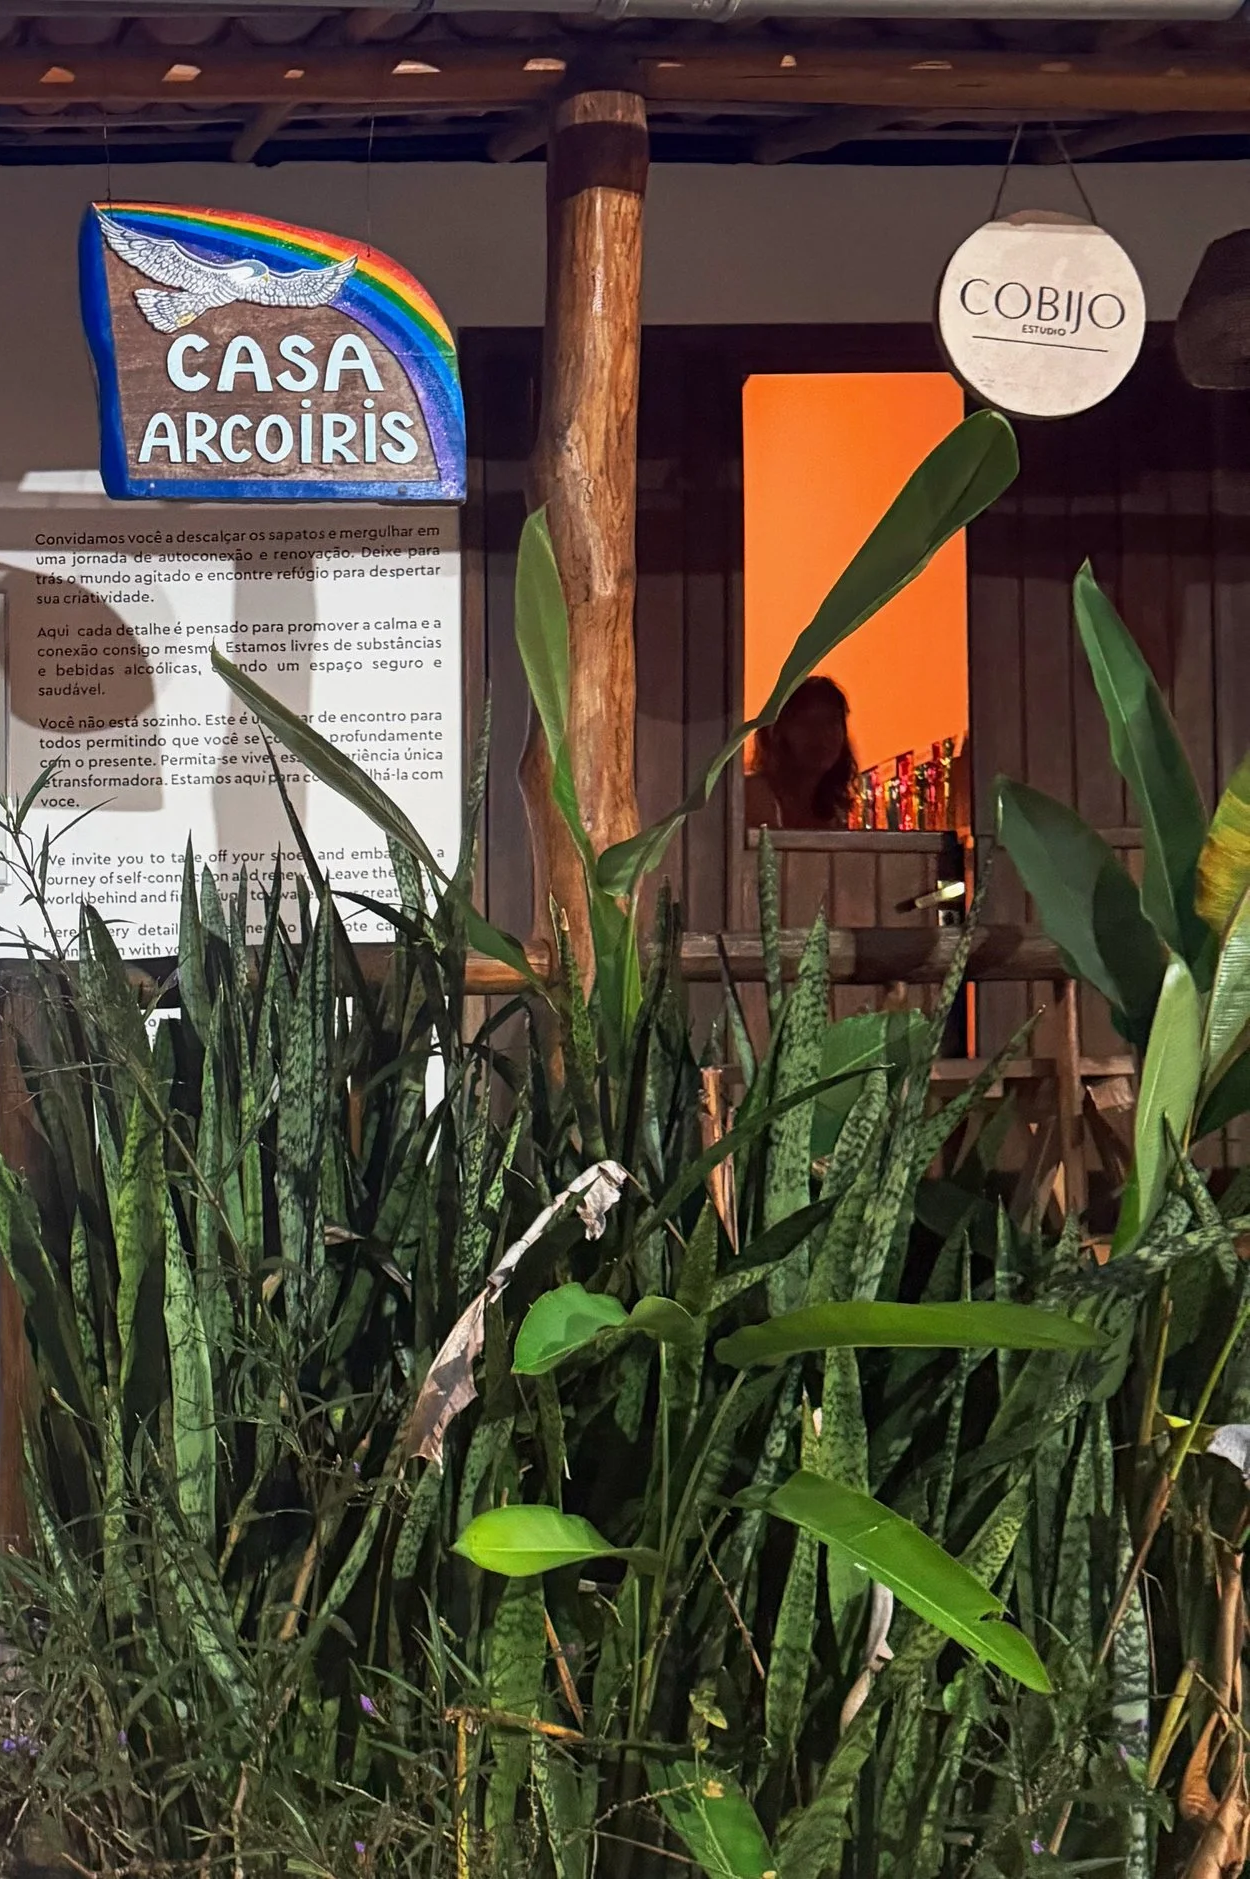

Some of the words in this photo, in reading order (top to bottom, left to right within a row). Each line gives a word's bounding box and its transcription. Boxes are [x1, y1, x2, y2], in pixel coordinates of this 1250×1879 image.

[960, 278, 1125, 334] COBIJO
[1022, 324, 1066, 336] ESTUDIO
[166, 333, 384, 392] CASA
[35, 533, 125, 546] Convidamos
[127, 531, 162, 544] você
[166, 534, 173, 543] a
[177, 530, 246, 545] descalçar
[250, 531, 265, 541] os
[269, 529, 325, 543] sapatos
[328, 530, 336, 539] e
[340, 525, 413, 541] mergulhar
[418, 527, 440, 536] em
[36, 555, 66, 565] uma
[72, 552, 127, 567] jornada
[133, 551, 152, 563] de
[159, 549, 253, 562] autoconexão
[259, 552, 268, 560] e
[274, 546, 354, 561] renovação.
[362, 545, 402, 558] Deixe
[408, 547, 440, 559] para
[36, 572, 63, 585] trás
[67, 576, 75, 584] o
[80, 571, 130, 584] mundo
[135, 570, 190, 585] agitado
[195, 573, 203, 581] e
[208, 569, 272, 581] encontre
[277, 567, 329, 581] refúgio
[333, 568, 365, 580] para
[369, 565, 441, 578] despertar
[37, 595, 59, 604] sua
[64, 591, 154, 604] criatividade.
[37, 624, 69, 639] Aqui
[78, 624, 112, 636] cada
[116, 622, 170, 636] detalhe
[174, 622, 182, 634] é
[187, 621, 248, 636] pensado
[252, 623, 284, 635] para
[288, 620, 359, 634] promover
[363, 621, 370, 630] a
[374, 618, 417, 630] calma
[421, 620, 430, 629] e
[433, 619, 441, 629] a
[37, 644, 98, 657] conexão
[103, 644, 160, 657] consigo
[226, 641, 286, 653] Estamos
[291, 639, 329, 651] livres
[334, 638, 352, 650] de
[357, 636, 442, 650] substâncias
[38, 668, 46, 676] e
[56, 664, 114, 676] bebidas
[124, 662, 202, 677] alcoólicas,
[277, 662, 299, 672] um
[310, 661, 362, 673] espaço
[372, 658, 424, 671] seguro
[434, 659, 442, 667] e
[38, 683, 105, 696] saudável.
[39, 716, 74, 728] Você
[79, 716, 104, 728] não
[108, 714, 138, 728] está
[142, 714, 201, 727] sozinho.
[205, 714, 236, 726] Este
[239, 712, 248, 725] é
[318, 711, 336, 722] de
[340, 711, 406, 722] encontro
[411, 712, 442, 723] para
[40, 737, 81, 749] todos
[86, 734, 166, 750] permitindo
[172, 735, 199, 748] que
[204, 732, 238, 745] você
[244, 735, 259, 744] se
[330, 729, 442, 743] profundamente
[75, 759, 84, 768] o
[89, 755, 156, 769] presente.
[161, 753, 238, 765] Permita-se
[404, 747, 443, 760] única
[52, 774, 168, 788] transformadora.
[172, 773, 231, 785] Estamos
[235, 770, 265, 785] aqui
[412, 769, 443, 780] com
[41, 798, 80, 808] voce.
[72, 853, 111, 865] invite
[118, 855, 144, 867] you
[150, 854, 164, 864] to
[209, 850, 227, 863] off
[232, 851, 264, 864] your
[318, 848, 344, 860] and
[437, 849, 444, 858] a
[46, 875, 95, 887] ourney
[100, 872, 114, 884] of
[373, 867, 395, 879] the
[87, 891, 137, 904] behind
[140, 891, 167, 902] and
[138, 923, 178, 936] detail
[129, 944, 162, 956] with
